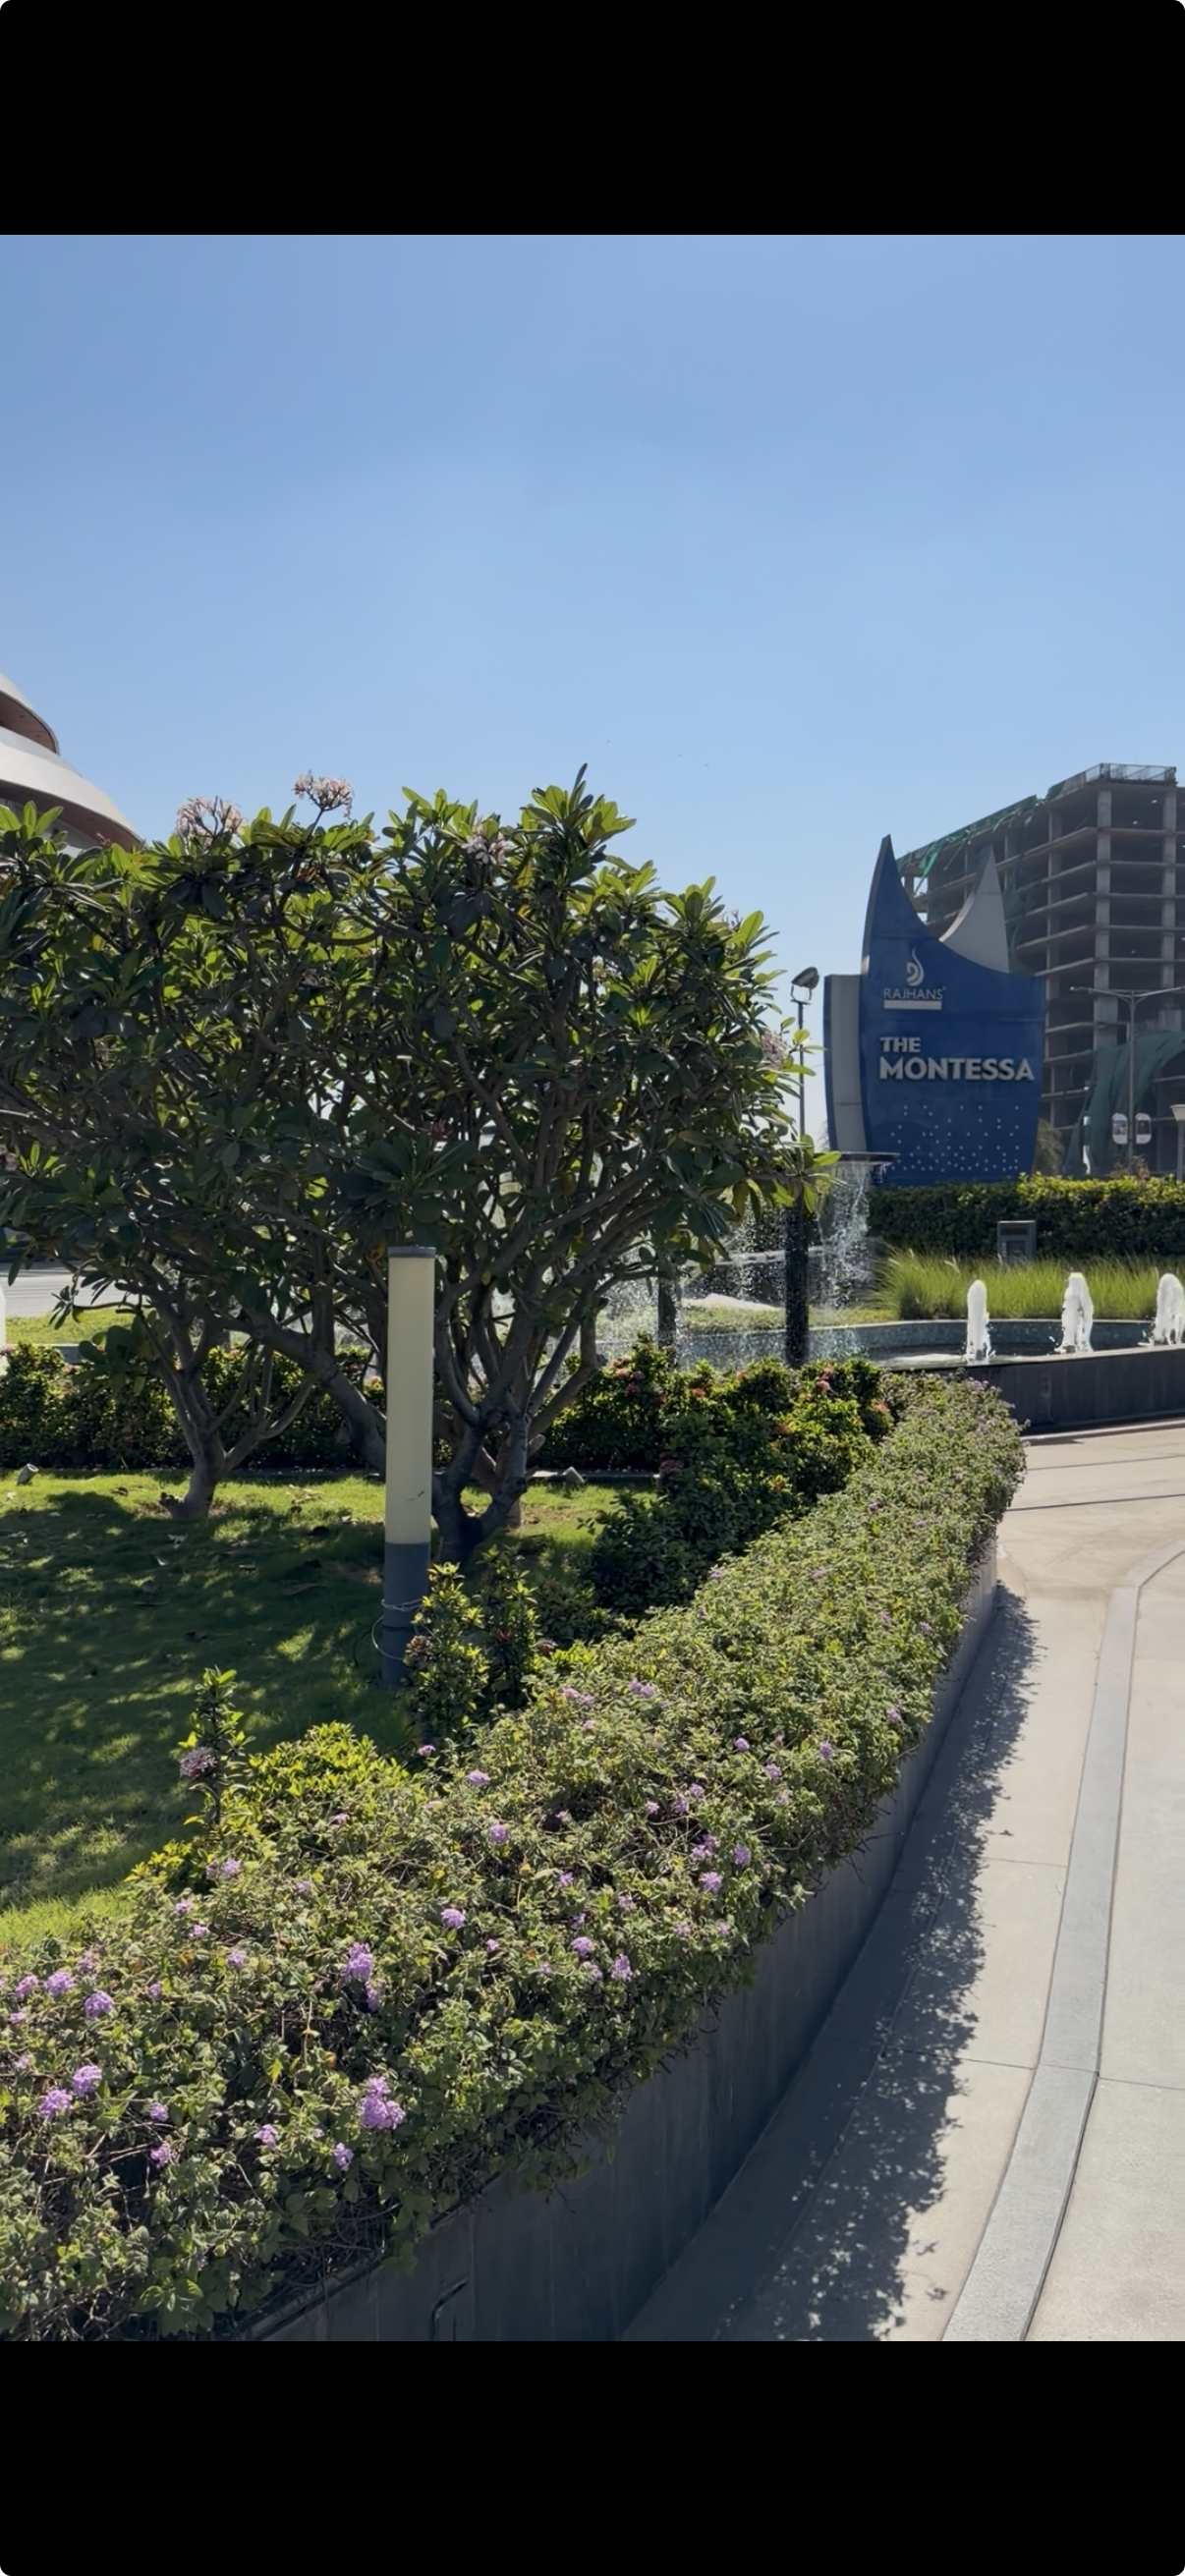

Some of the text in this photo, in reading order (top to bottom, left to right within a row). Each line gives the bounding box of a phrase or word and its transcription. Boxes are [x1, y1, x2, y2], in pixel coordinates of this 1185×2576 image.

[883, 987, 943, 1000] RAJHANS
[879, 1036, 922, 1053] THE
[879, 1056, 1035, 1081] MONTESSA
